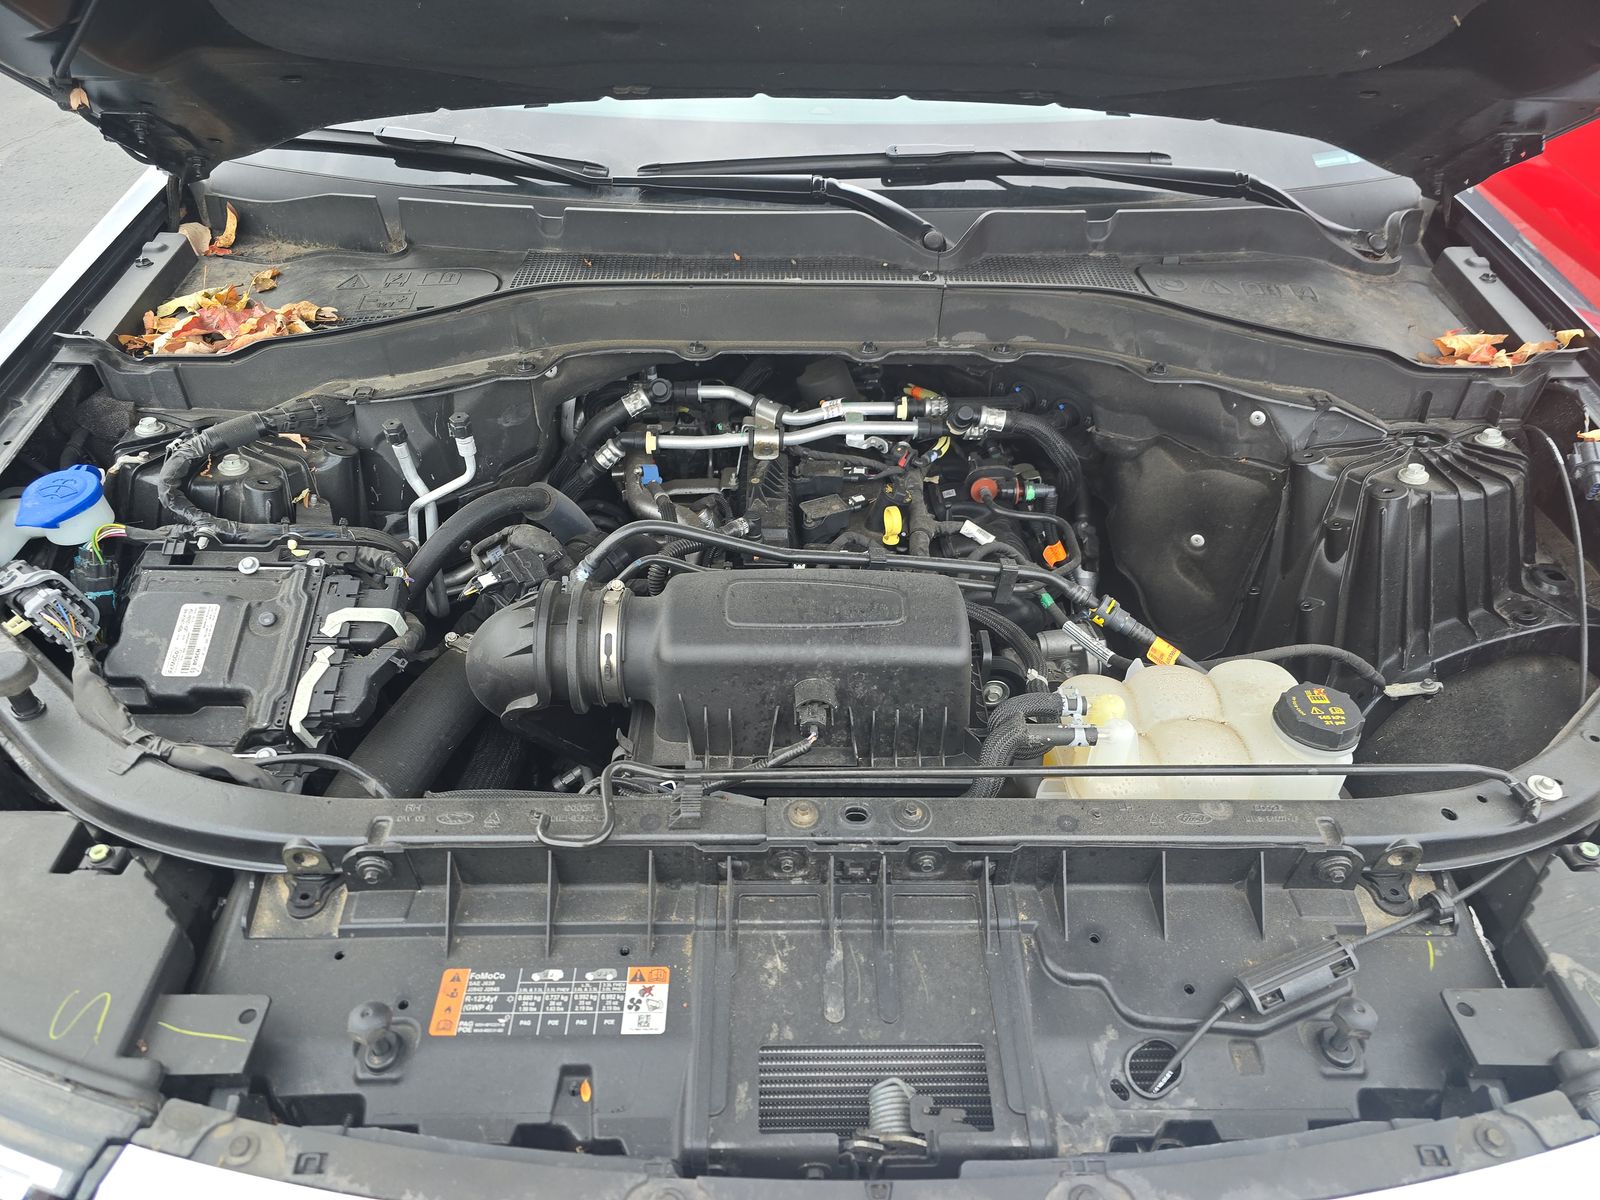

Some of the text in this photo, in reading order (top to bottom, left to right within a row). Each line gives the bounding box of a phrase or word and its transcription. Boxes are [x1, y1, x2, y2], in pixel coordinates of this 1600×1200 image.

[192, 648, 201, 666] BOSCH
[469, 972, 506, 980] FoMoCo
[464, 995, 498, 1004] R-1234yf
[560, 994, 569, 1002] kg
[463, 1004, 494, 1012] (GWP 4)
